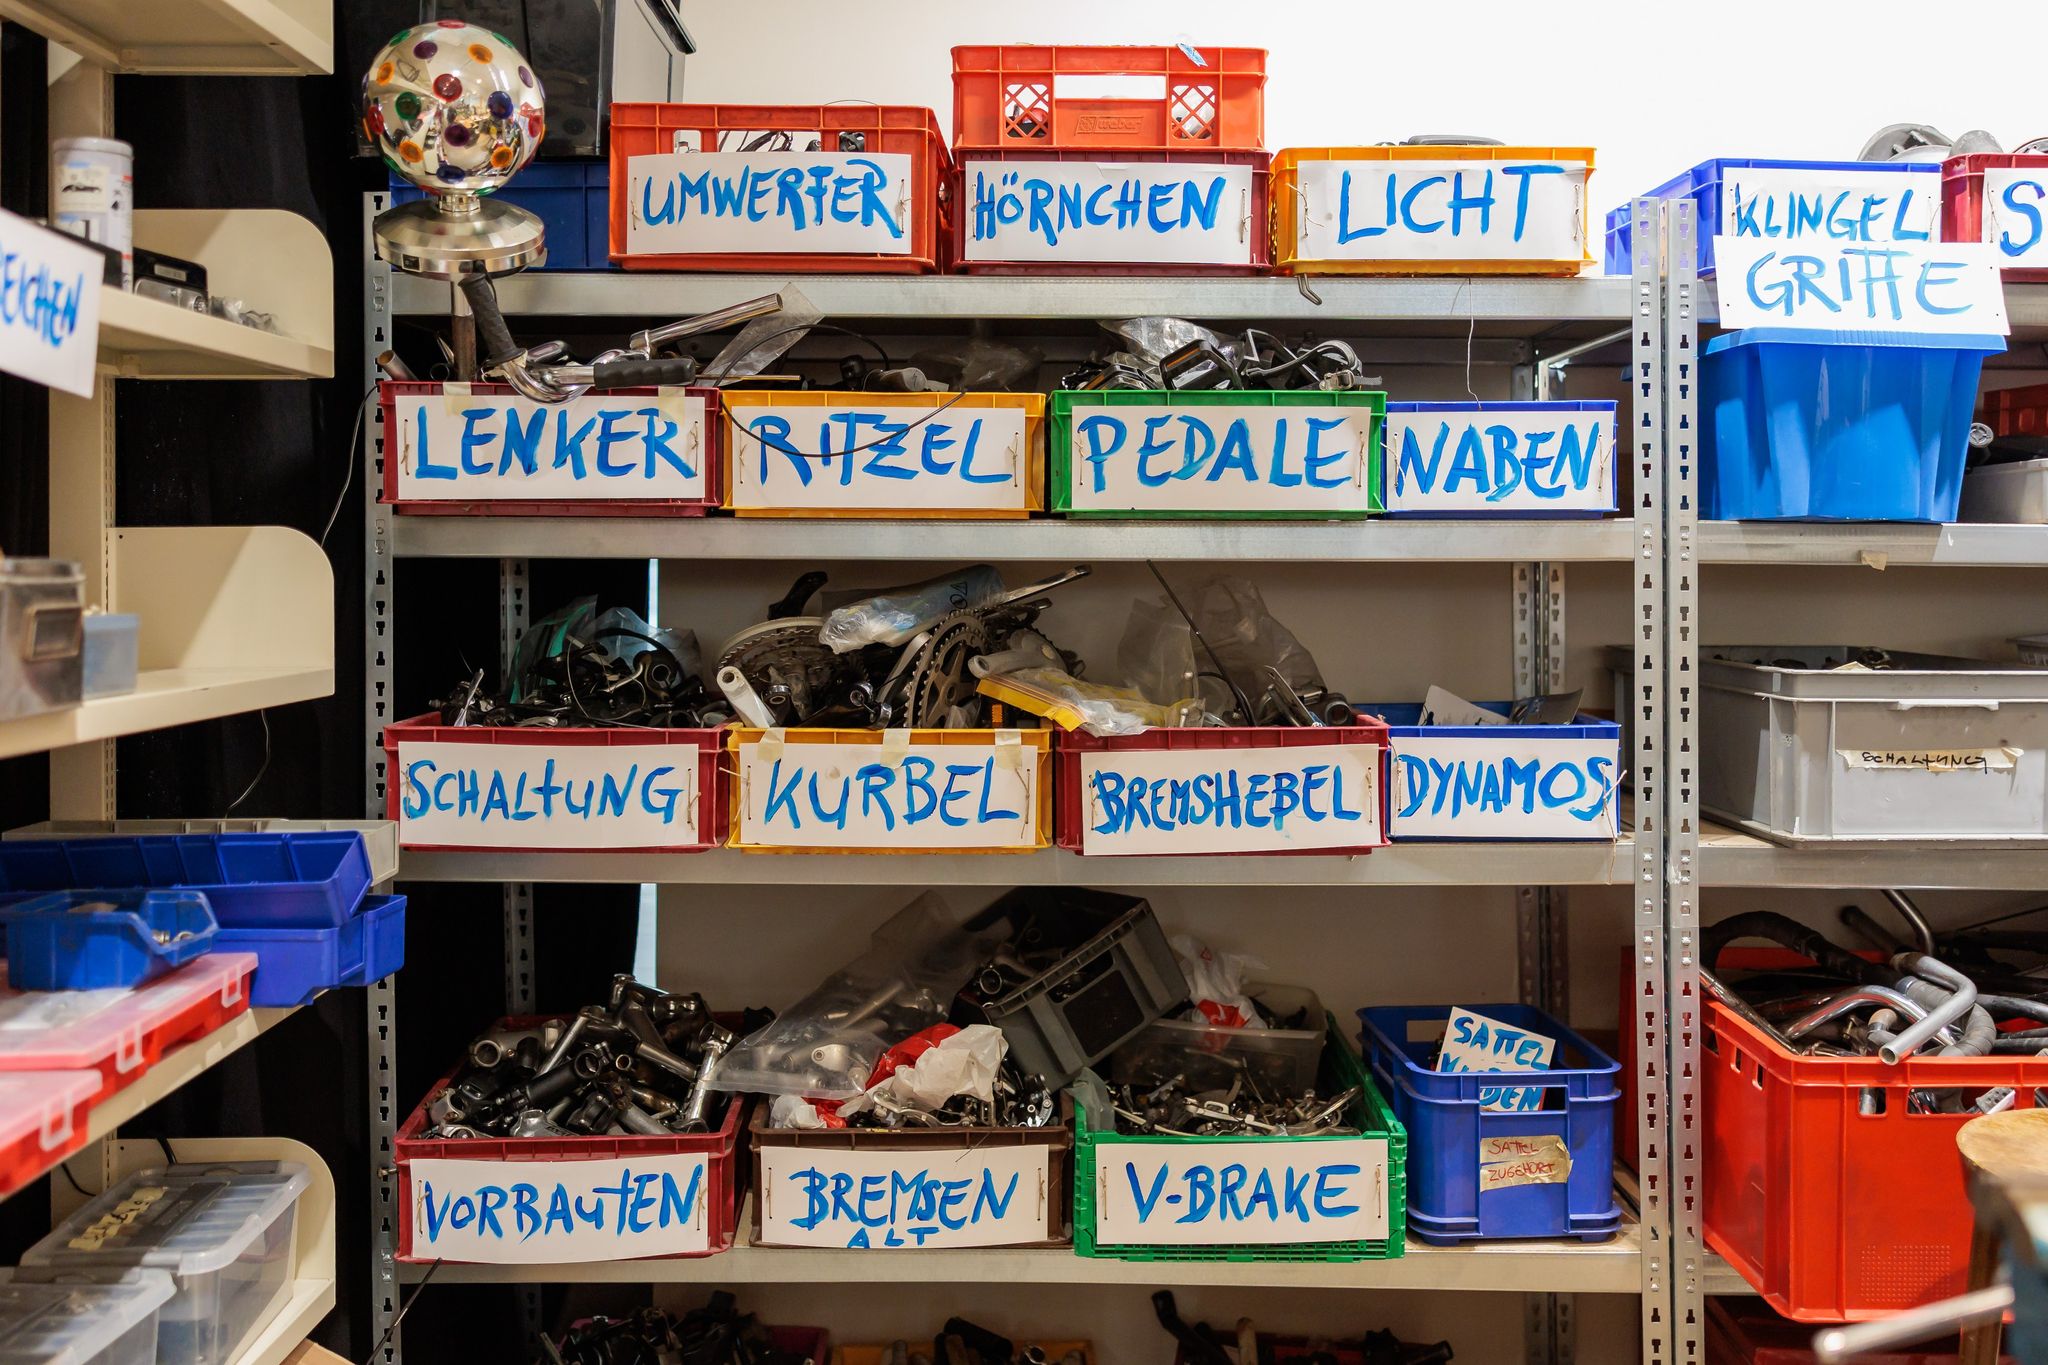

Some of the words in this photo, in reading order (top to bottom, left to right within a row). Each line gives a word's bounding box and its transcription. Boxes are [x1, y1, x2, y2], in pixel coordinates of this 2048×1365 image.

[643, 159, 902, 239] UMWERFER
[976, 171, 1226, 246] HÖRNCHEN
[1337, 164, 1565, 245] LICHT
[1734, 182, 1929, 242] KLINGEL
[1746, 247, 1973, 320] GRIFFE
[415, 406, 696, 481] LENKER
[753, 412, 1013, 487] RITZEL
[1082, 414, 1352, 494] PEDALE
[1396, 421, 1600, 503] NABEN
[403, 759, 683, 824] SCHALTUNG
[764, 756, 1020, 832] KURBEL
[1092, 765, 1362, 834] BREMSHEBEL
[1394, 754, 1613, 821] DYNAMOS
[1454, 1016, 1550, 1071] SATTEL
[1488, 1139, 1540, 1156] SATTEL
[425, 1164, 703, 1244] VORBAUTEN
[789, 1167, 1019, 1231] BREMSEN
[1126, 1161, 1360, 1224] V-BRAKE
[847, 1226, 940, 1249] ALT
